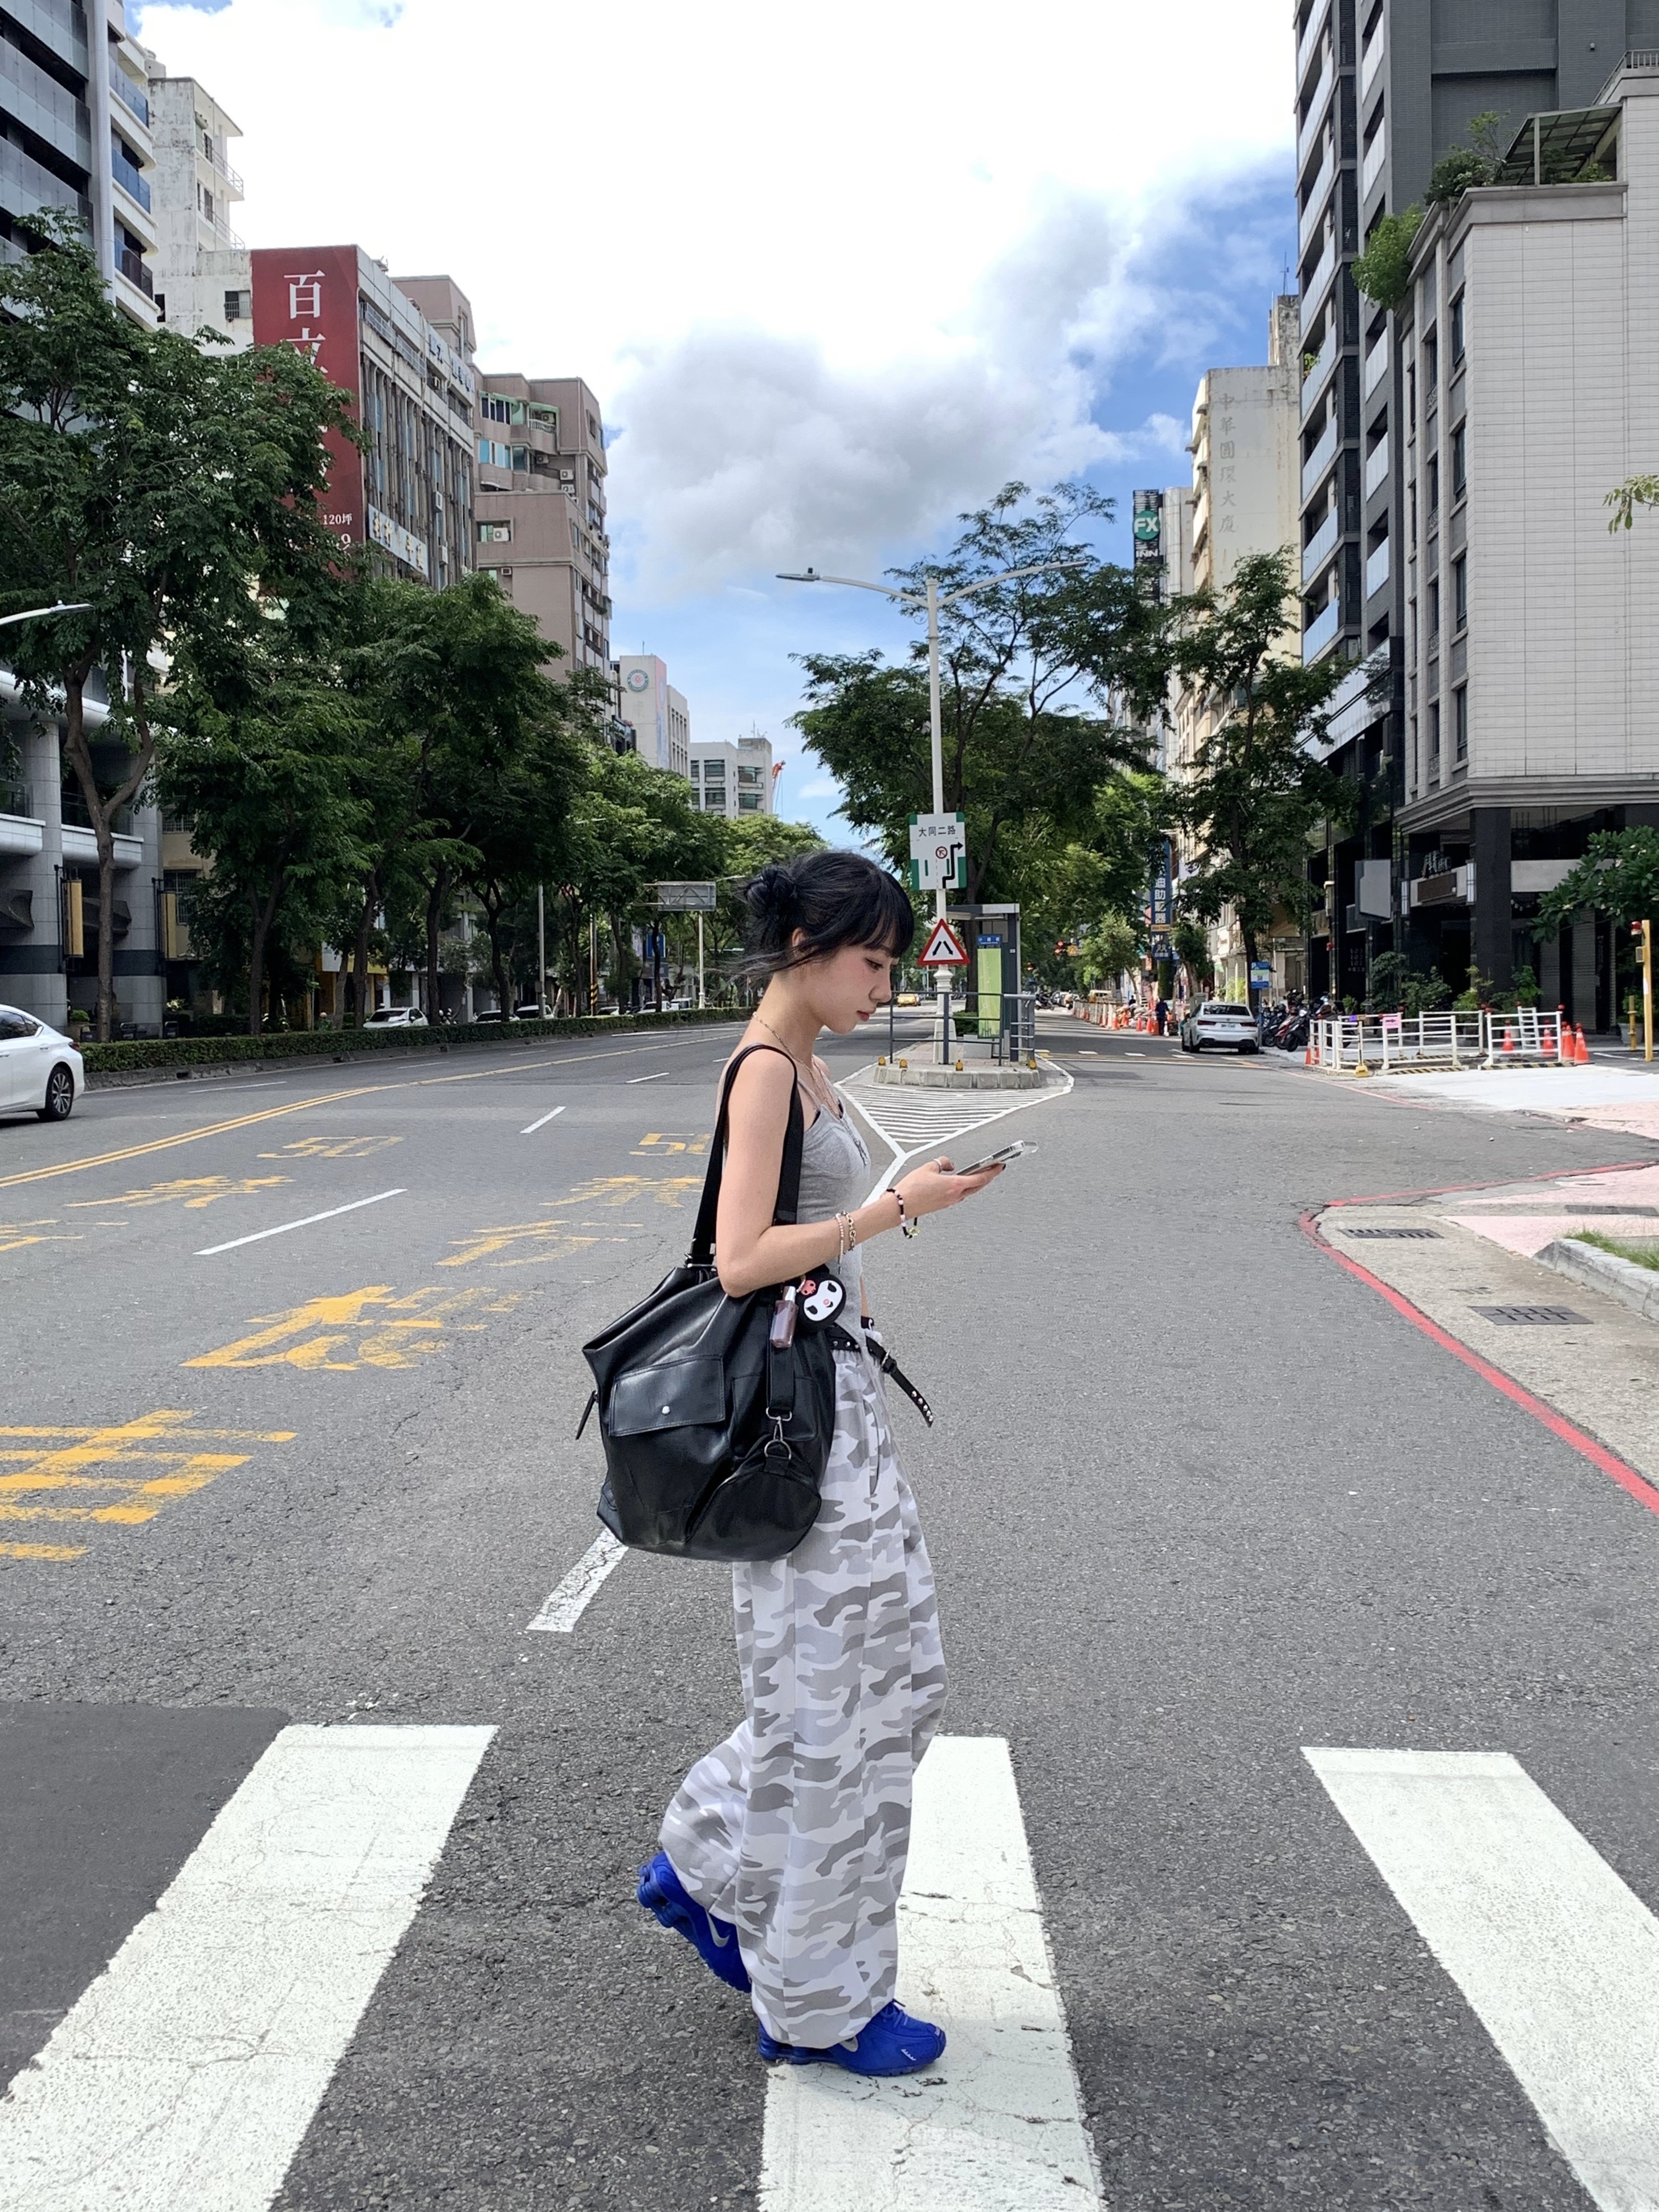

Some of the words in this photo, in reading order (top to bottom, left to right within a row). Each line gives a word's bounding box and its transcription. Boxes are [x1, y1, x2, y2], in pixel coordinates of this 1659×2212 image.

[323, 513, 352, 529] 120坪
[1134, 517, 1159, 533] FX
[919, 826, 956, 837] 大同二路
[257, 1137, 404, 1158] 50
